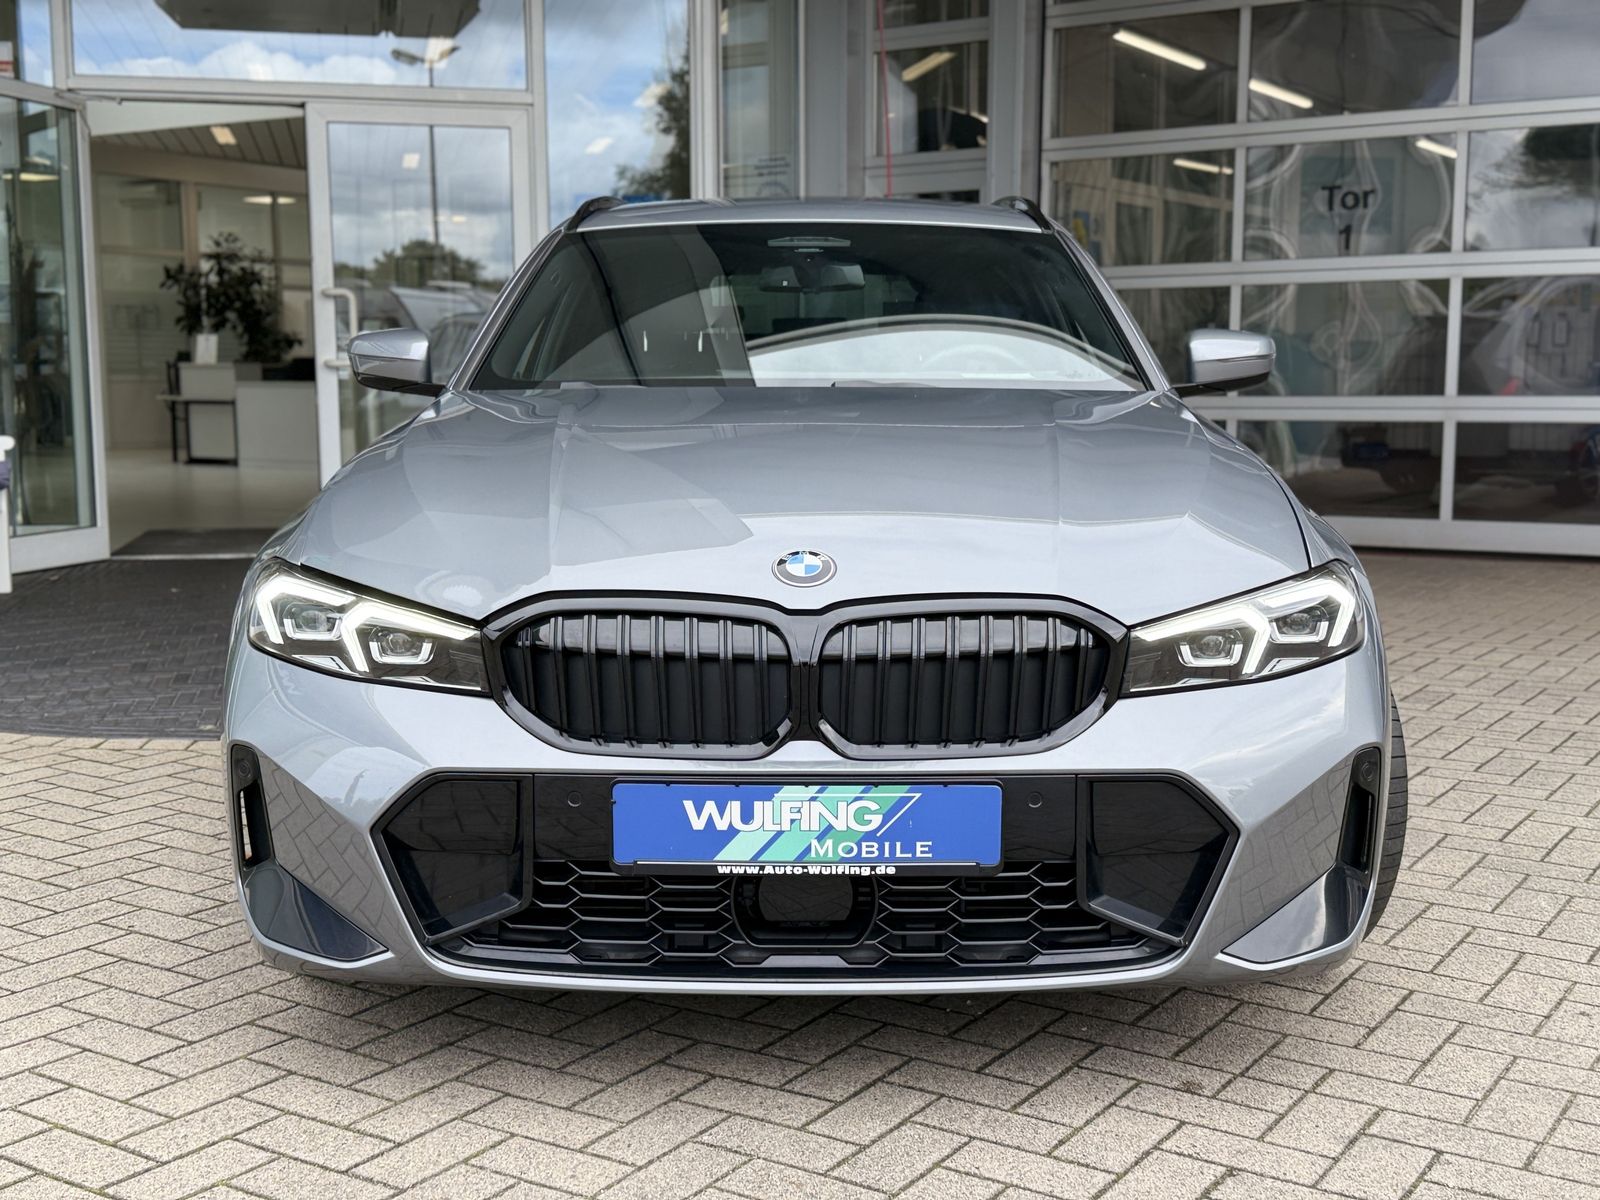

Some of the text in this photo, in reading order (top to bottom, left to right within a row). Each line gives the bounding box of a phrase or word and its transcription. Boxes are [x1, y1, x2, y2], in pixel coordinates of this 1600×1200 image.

[1321, 185, 1376, 212] Tor
[1339, 224, 1353, 250] 1
[682, 800, 884, 832] WULFING
[810, 839, 933, 858] MOBILE
[717, 865, 896, 876] www.Auto-Wulfing.de
